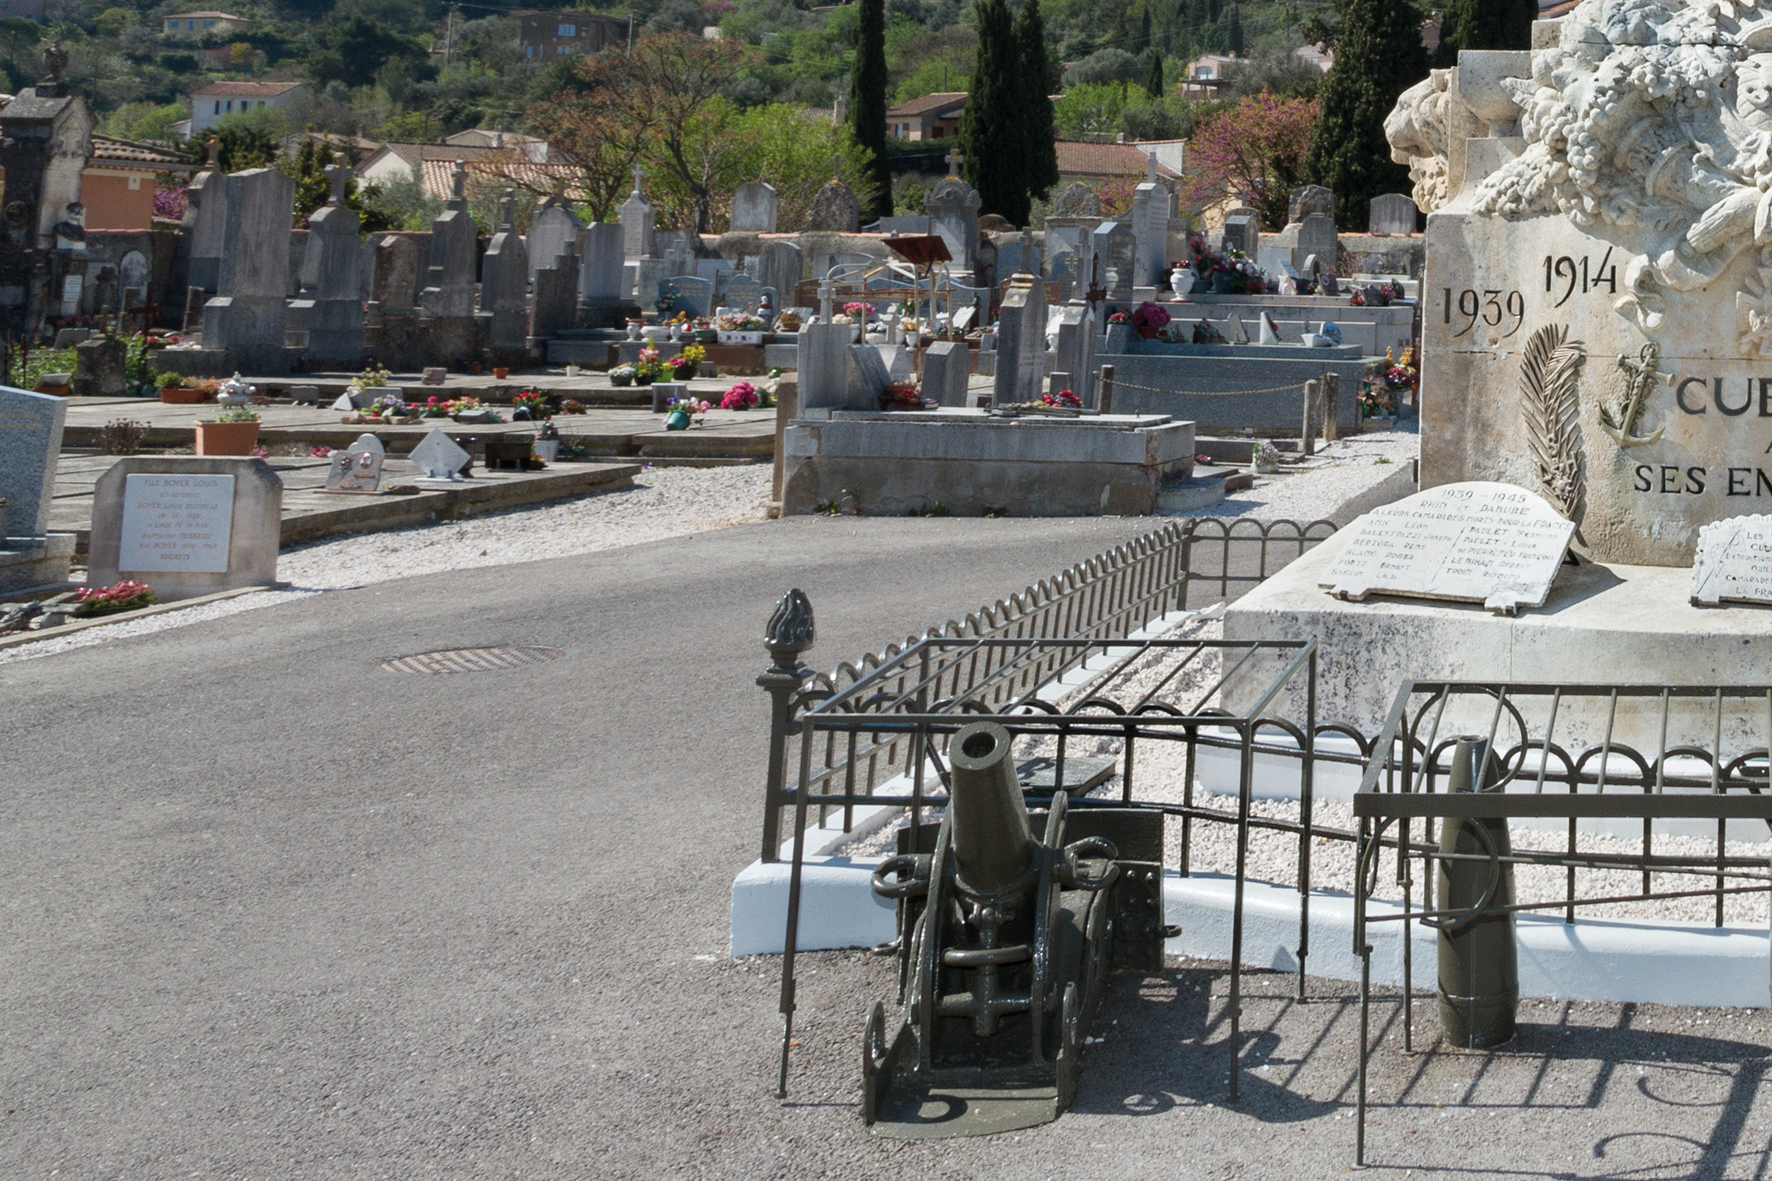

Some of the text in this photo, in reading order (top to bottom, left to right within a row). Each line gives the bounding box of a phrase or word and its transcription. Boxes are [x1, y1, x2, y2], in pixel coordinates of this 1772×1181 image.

[1541, 245, 1618, 309] 1914
[1443, 287, 1525, 338] 1939
[1633, 465, 1708, 496] SES
[1441, 489, 1474, 502] 1939
[1491, 492, 1526, 504] 1945
[1479, 504, 1530, 516] DANUBE
[1747, 532, 1764, 540] LES
